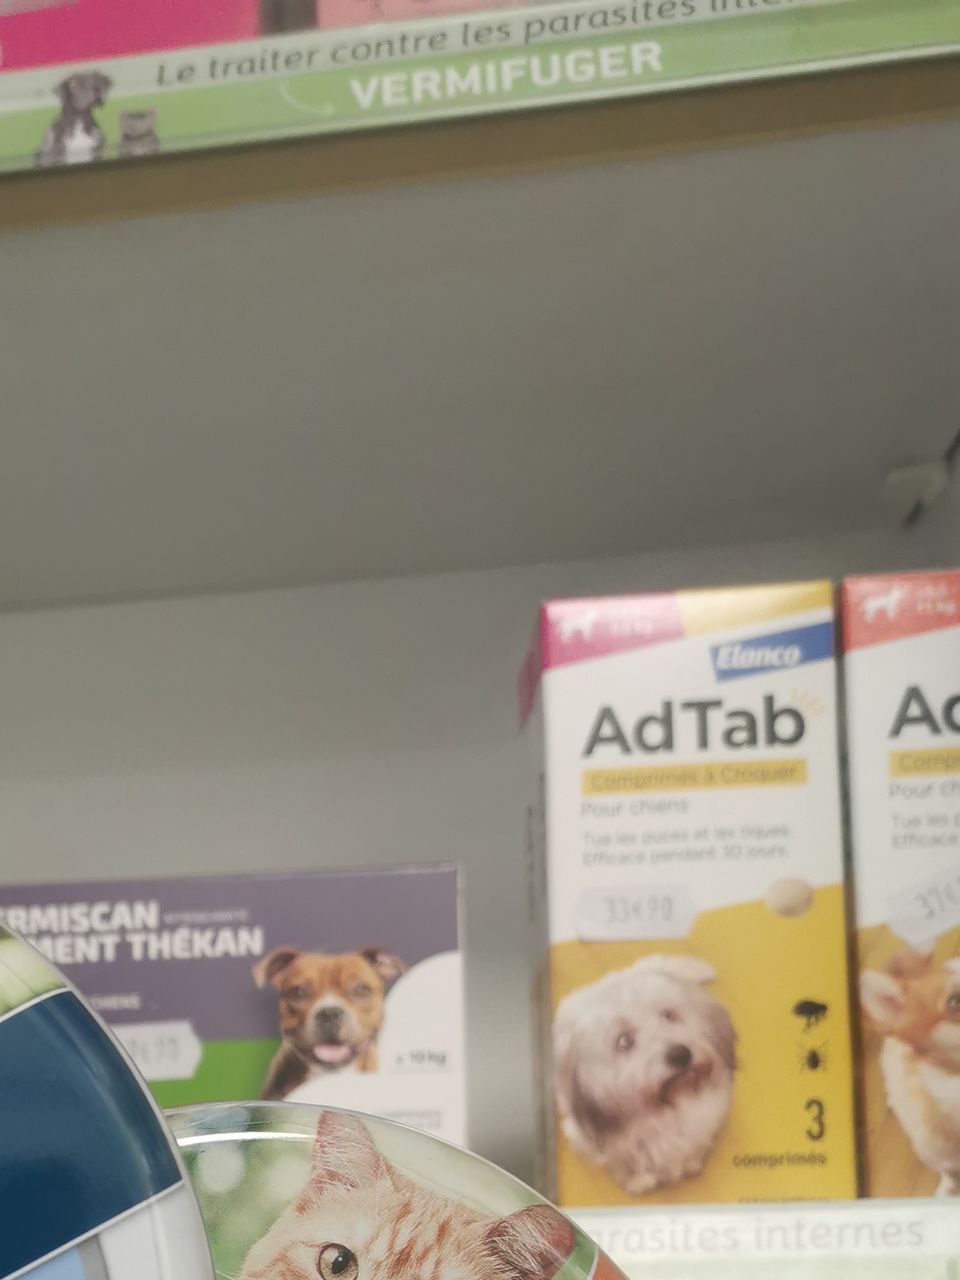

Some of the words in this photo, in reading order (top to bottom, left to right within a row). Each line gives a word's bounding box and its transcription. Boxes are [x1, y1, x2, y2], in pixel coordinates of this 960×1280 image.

[155, 62, 198, 87] Le
[208, 45, 319, 79] traiter
[330, 28, 449, 67] contre
[459, 17, 512, 49] les
[350, 41, 665, 110] VERMIFUGER
[716, 642, 801, 672] Elanco
[581, 695, 807, 759] AdTab
[580, 800, 623, 818] Pour
[629, 797, 690, 816] chiens
[125, 924, 265, 962] THÉKAN
[804, 1098, 825, 1141] 3
[596, 1216, 739, 1254] rasites
[753, 1216, 924, 1251] internes
